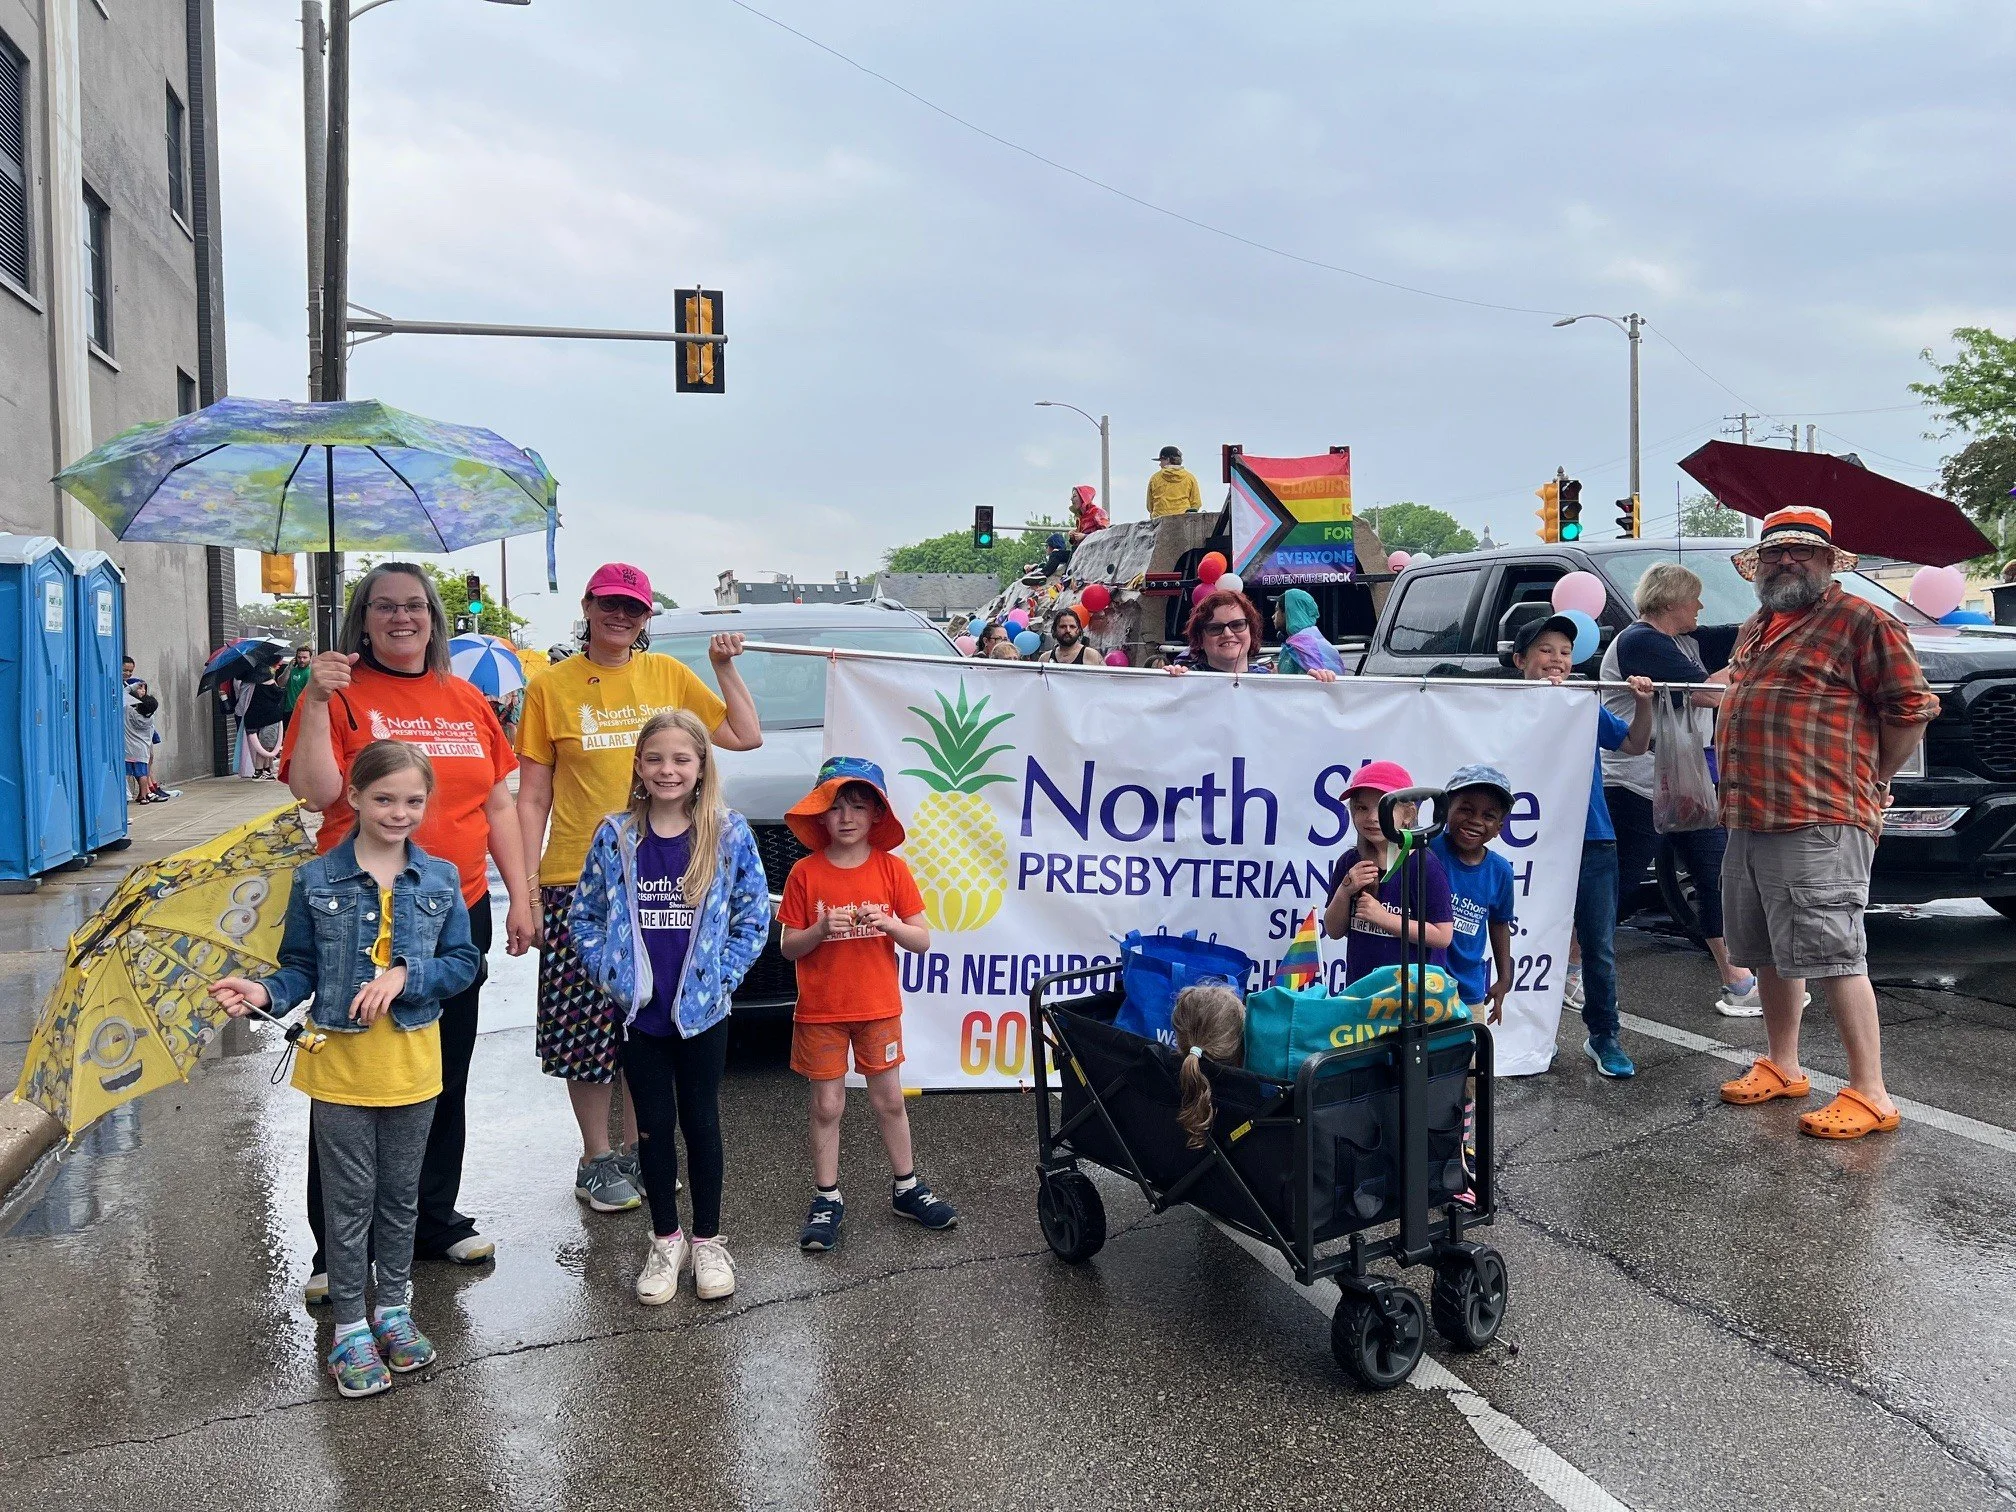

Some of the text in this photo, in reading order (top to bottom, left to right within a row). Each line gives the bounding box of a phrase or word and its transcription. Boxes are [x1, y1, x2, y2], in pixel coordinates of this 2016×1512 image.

[1280, 479, 1350, 494] CLIMBING
[1341, 503, 1351, 516] IS
[1324, 526, 1352, 540] FOR
[1277, 549, 1354, 565] EVERYONE
[597, 704, 674, 721] North Shore
[386, 716, 475, 731] North Shore
[599, 717, 648, 727] PRESBYTERIAN
[391, 729, 477, 738] PRESBYTERIAN CHURCH
[587, 737, 606, 749] ALL
[609, 733, 628, 747] ARE
[425, 743, 481, 756] WELCOME!
[1020, 755, 1279, 846] North
[1018, 852, 1333, 899] PRESBYTERIAN
[637, 893, 682, 901] RESBYTERIAN
[1461, 898, 1487, 915] Shore
[659, 911, 694, 927] WELCO
[895, 952, 950, 994] UR
[1485, 954, 1552, 994] 122
